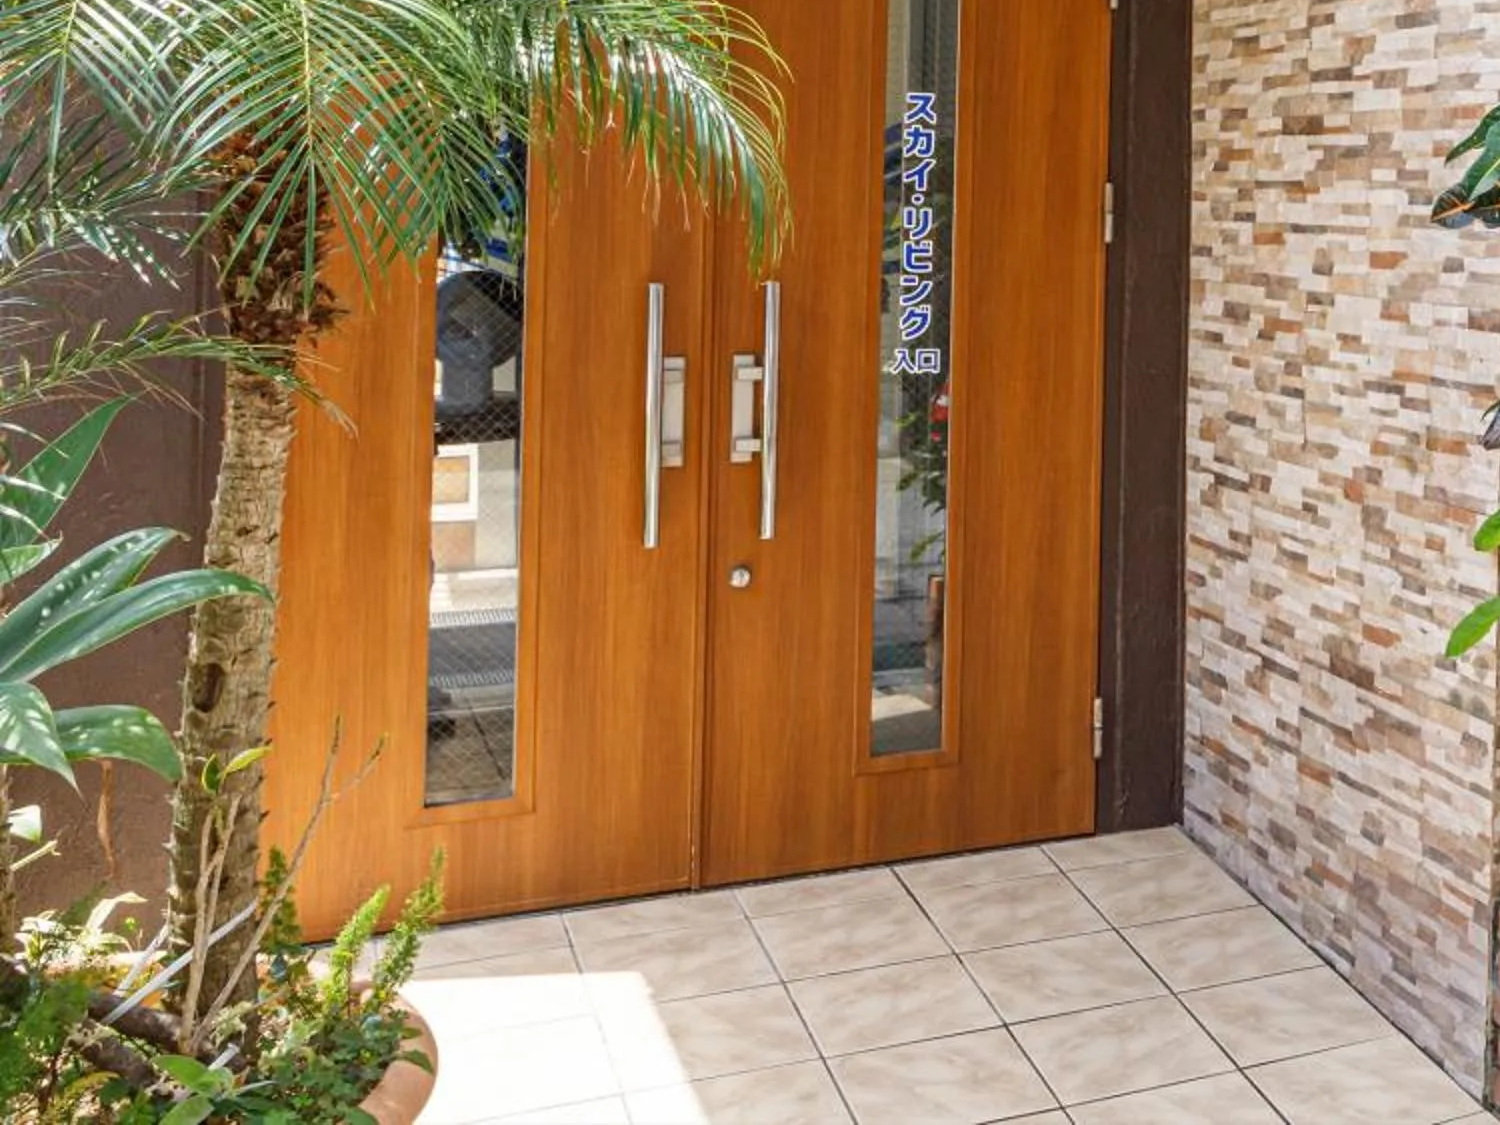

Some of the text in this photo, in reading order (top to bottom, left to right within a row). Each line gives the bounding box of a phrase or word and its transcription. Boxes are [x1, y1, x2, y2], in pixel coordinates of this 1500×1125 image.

[901, 92, 936, 341] スカイ・リビング
[892, 348, 941, 374] 入口
